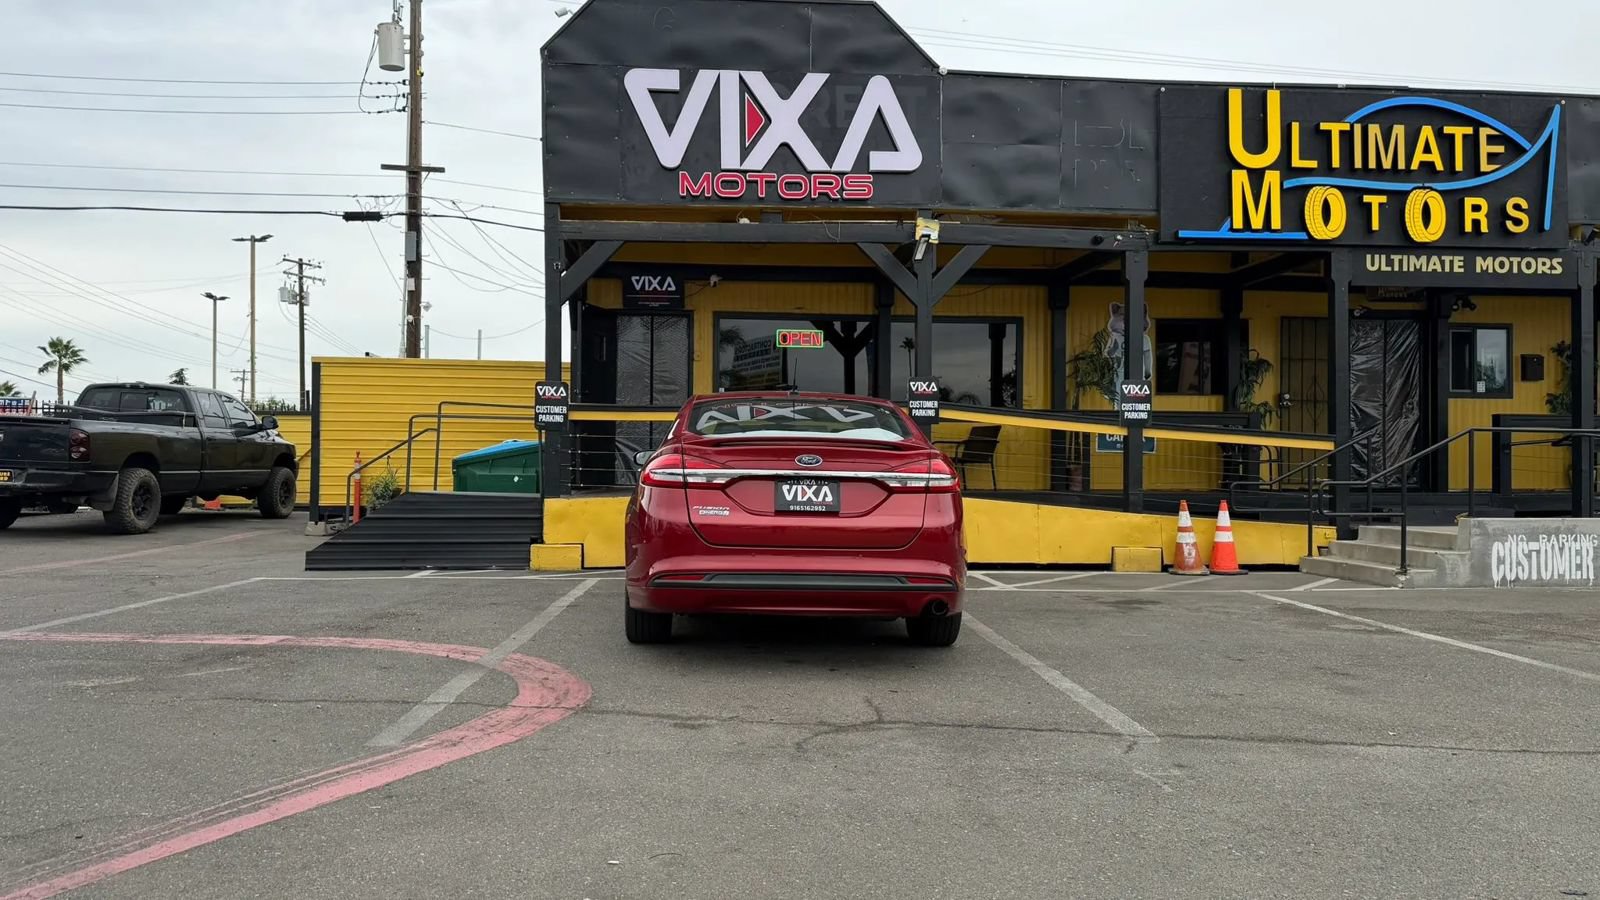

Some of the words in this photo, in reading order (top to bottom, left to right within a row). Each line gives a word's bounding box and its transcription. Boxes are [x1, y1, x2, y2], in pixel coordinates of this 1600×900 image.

[624, 69, 923, 173] VIXA
[1228, 88, 1506, 173] ULTIMATE
[679, 171, 874, 200] MOTORS
[1231, 169, 1530, 243] MOTORS
[1366, 253, 1465, 273] ULTIMATE
[1475, 255, 1563, 275] MOTORS
[631, 275, 676, 291] VIXA
[779, 331, 822, 346] OPEN
[536, 385, 567, 397] VIXA
[909, 381, 938, 392] VIXA
[1122, 384, 1150, 394] VIXA
[535, 405, 567, 414] CUSTOMER
[909, 400, 939, 409] CUSTOMER
[538, 414, 564, 423] PARKING
[912, 409, 936, 417] PARKING
[782, 484, 833, 502] VIXA
[1539, 534, 1599, 548] PARKING
[1491, 541, 1595, 582] CUSTOMER
